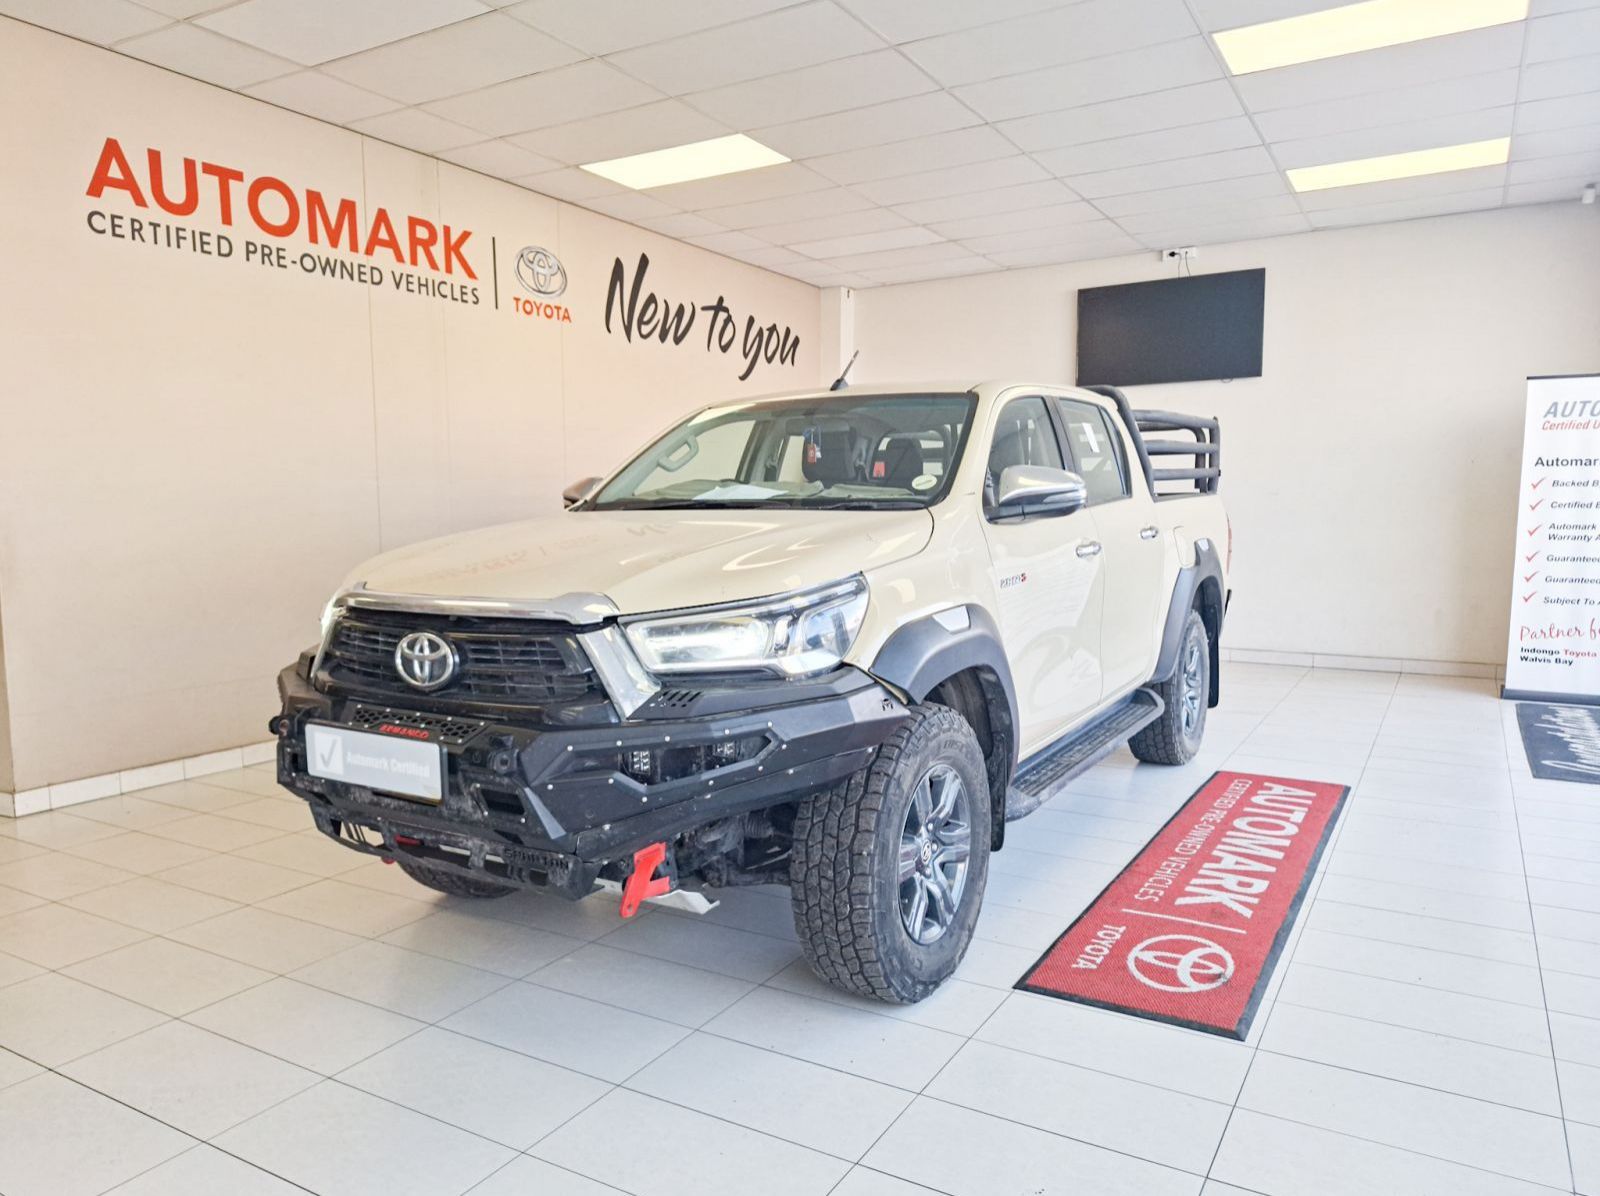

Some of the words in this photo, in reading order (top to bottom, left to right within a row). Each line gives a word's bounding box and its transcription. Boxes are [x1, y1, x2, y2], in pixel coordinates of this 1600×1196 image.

[86, 137, 478, 280] AUTOMARK
[87, 210, 234, 258] CERTIFIED
[246, 241, 384, 286] PRE-OWNED
[392, 270, 480, 305] VEHICLES
[513, 297, 572, 323] TOYOTA
[605, 252, 696, 346] New
[700, 295, 736, 354] to
[738, 314, 800, 382] you
[1542, 420, 1591, 431] Certified
[1534, 456, 1600, 468] Automar
[1552, 479, 1590, 488] Backed
[1550, 501, 1593, 509] Certified
[1549, 522, 1596, 531] Automark
[1548, 533, 1593, 543] Warranty
[1543, 596, 1581, 606] Subject
[1584, 598, 1595, 606] To
[1520, 622, 1584, 642] Partner
[1519, 656, 1552, 664] Walvis
[1554, 657, 1574, 666] Bay
[1520, 646, 1560, 656] Indongo
[1563, 649, 1597, 658] Toyota
[1213, 779, 1252, 808] CERTIFIED
[1174, 809, 1228, 855] PRE-OWNED
[1174, 782, 1317, 919] AUTOMARK
[1134, 856, 1186, 902] VEHICLES
[1071, 924, 1126, 969] TOYOTA
